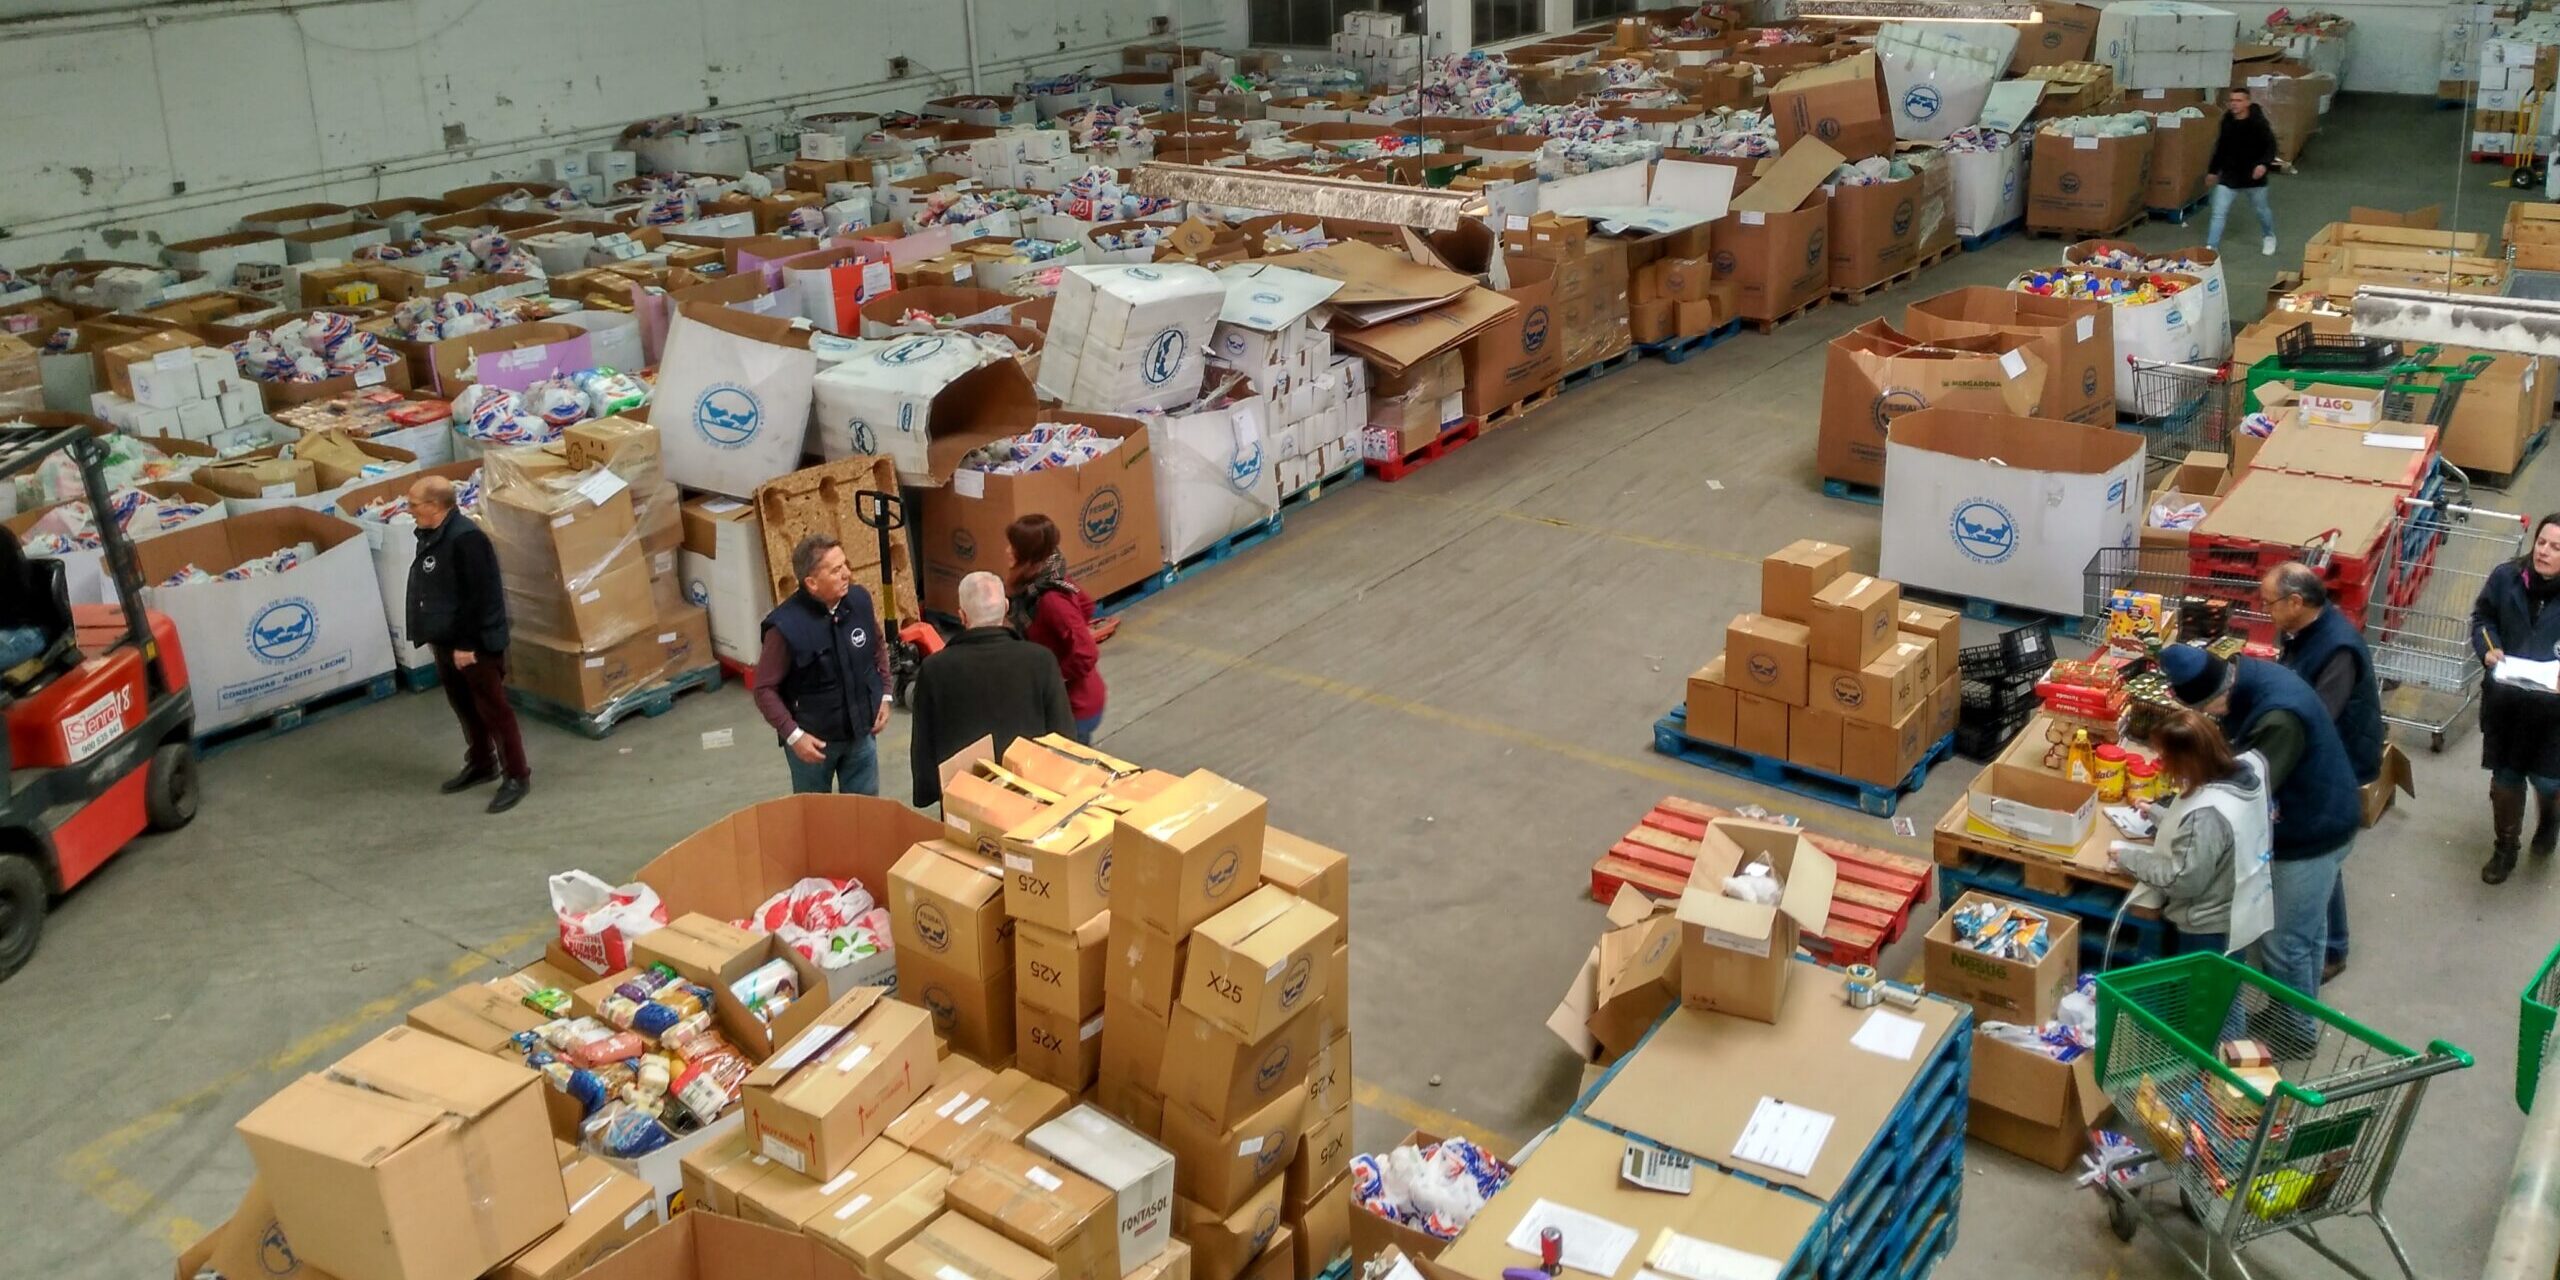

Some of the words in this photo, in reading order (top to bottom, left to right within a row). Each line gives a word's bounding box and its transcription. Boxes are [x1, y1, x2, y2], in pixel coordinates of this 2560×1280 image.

[222, 680, 276, 700] CONSERVAS
[283, 667, 313, 683] ACEITE
[320, 655, 347, 671] LECHE
[1018, 874, 1050, 899] X25
[1030, 960, 1063, 988] X25
[1207, 970, 1243, 1004] X25
[1031, 1026, 1063, 1055] X25
[1310, 1068, 1336, 1101] X25
[1320, 1131, 1344, 1166] X25
[1121, 1196, 1169, 1235] FONTASOL
